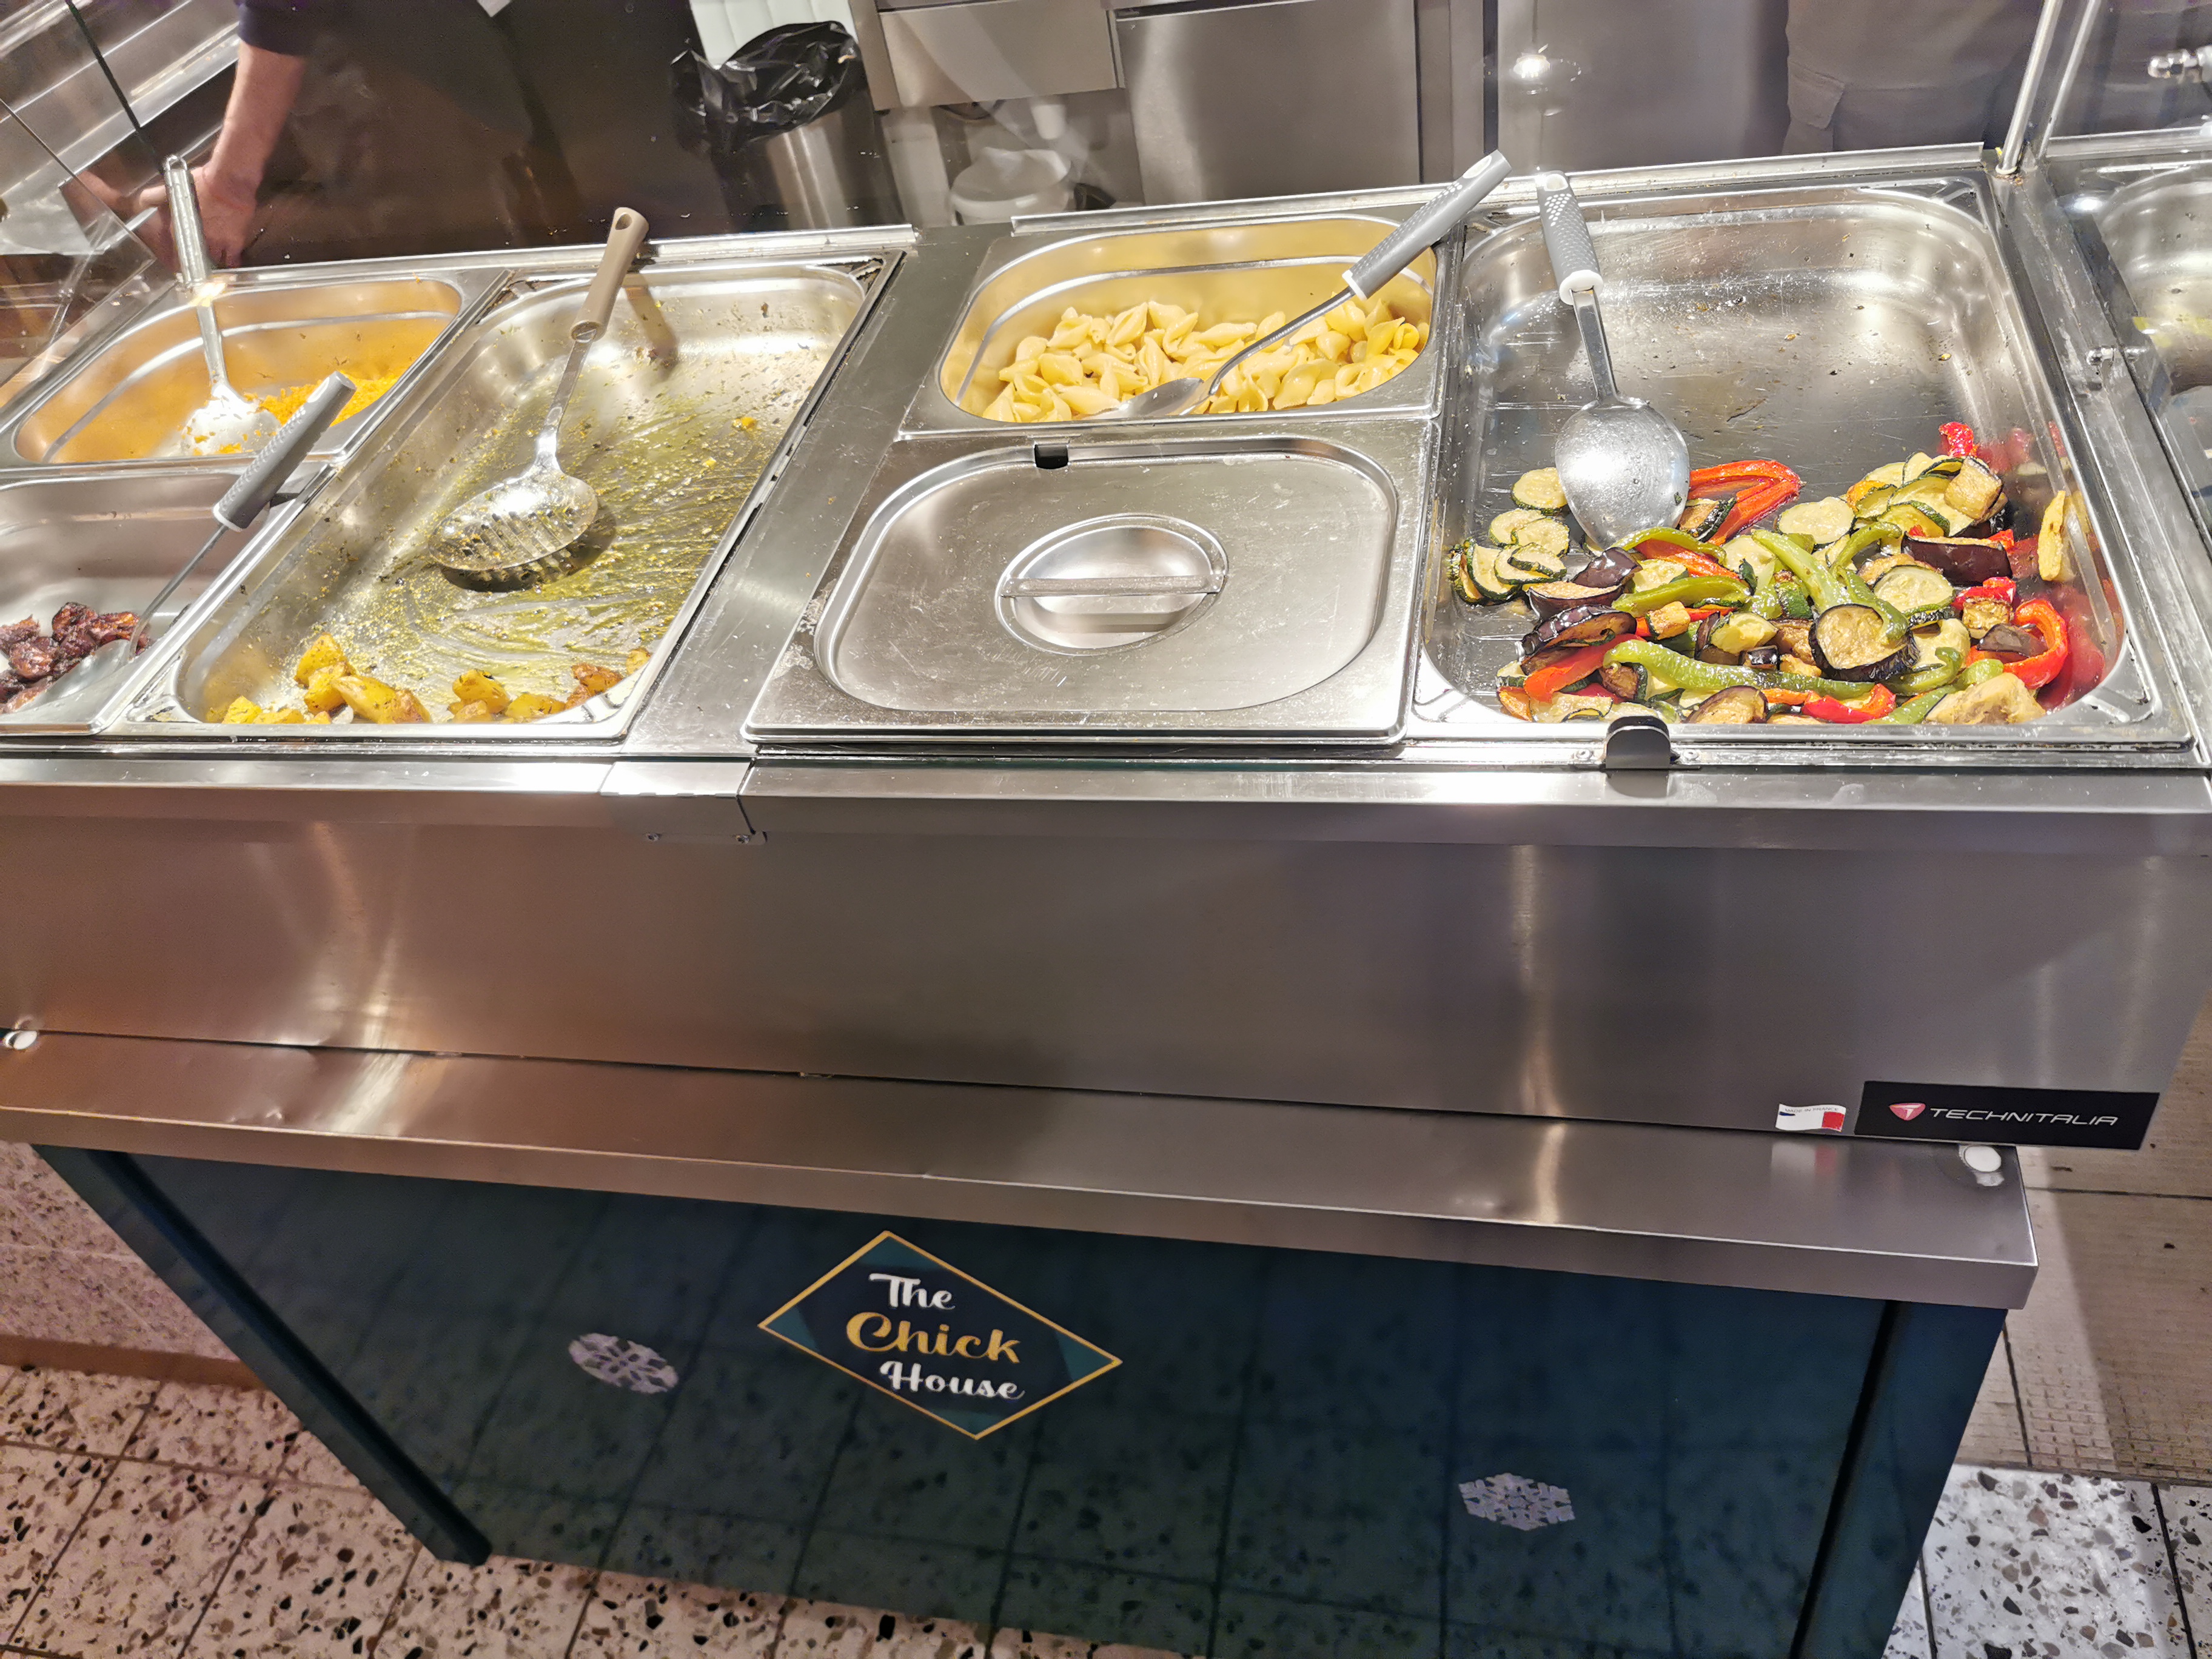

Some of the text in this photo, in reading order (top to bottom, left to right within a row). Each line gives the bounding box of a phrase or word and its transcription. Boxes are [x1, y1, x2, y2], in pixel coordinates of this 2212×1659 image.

[1929, 1107, 2119, 1127] TECHNITALIA
[869, 1273, 956, 1310] The
[846, 1312, 1021, 1364] Chick
[879, 1360, 1025, 1400] House
